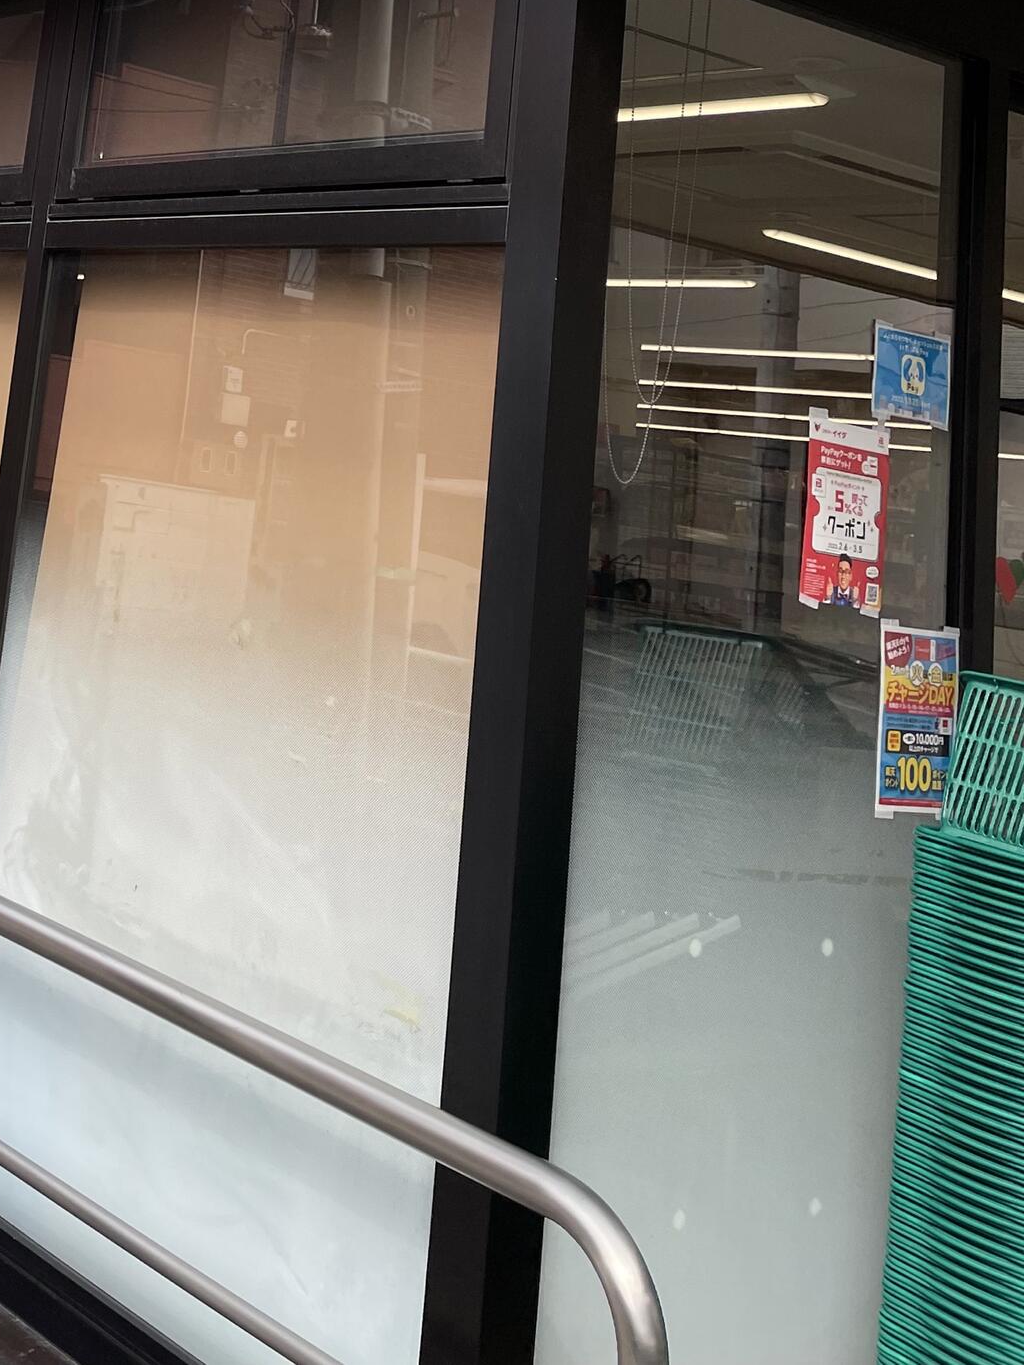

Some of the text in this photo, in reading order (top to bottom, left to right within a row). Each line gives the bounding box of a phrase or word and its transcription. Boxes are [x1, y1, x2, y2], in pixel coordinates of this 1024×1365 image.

[827, 515, 866, 540] クーポン
[887, 680, 955, 707] チャージDAY
[897, 756, 931, 792] 100
